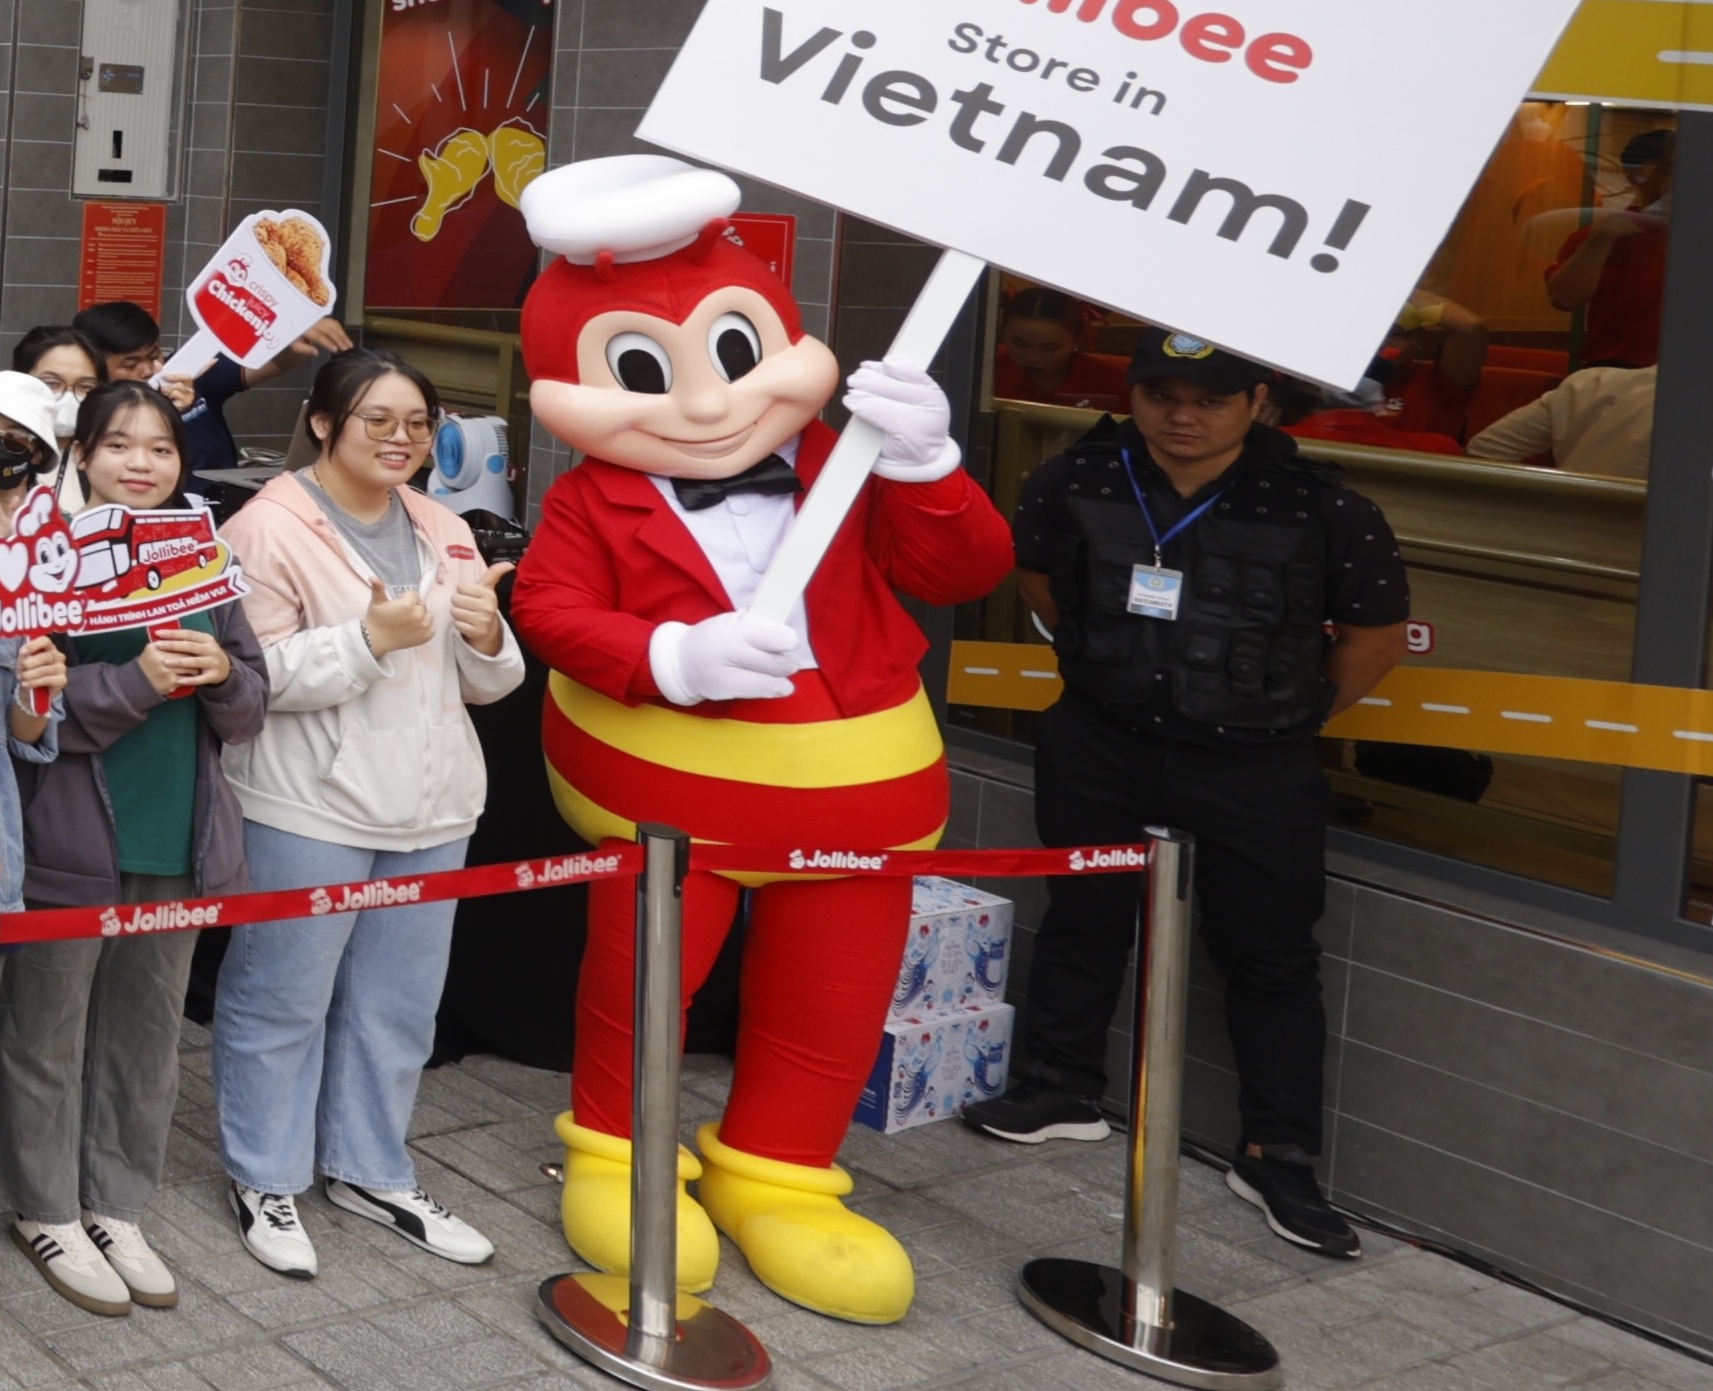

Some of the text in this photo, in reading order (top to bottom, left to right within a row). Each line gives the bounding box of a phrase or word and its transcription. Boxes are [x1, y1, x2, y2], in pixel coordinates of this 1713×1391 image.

[948, 22, 1167, 116] Store in
[759, 6, 1371, 273] Vietnam!
[249, 281, 279, 307] crispy
[208, 280, 280, 349] Chickenjoy
[144, 541, 195, 563] Jollibee
[90, 613, 118, 626] HÀNH
[147, 607, 167, 619] LAN
[211, 585, 227, 599] VUI
[537, 855, 618, 882] Jollibee
[806, 850, 882, 870] Jollibee
[1087, 848, 1146, 867] Jollibe
[335, 881, 421, 910] Jollibee
[124, 902, 218, 932] Jollibee
